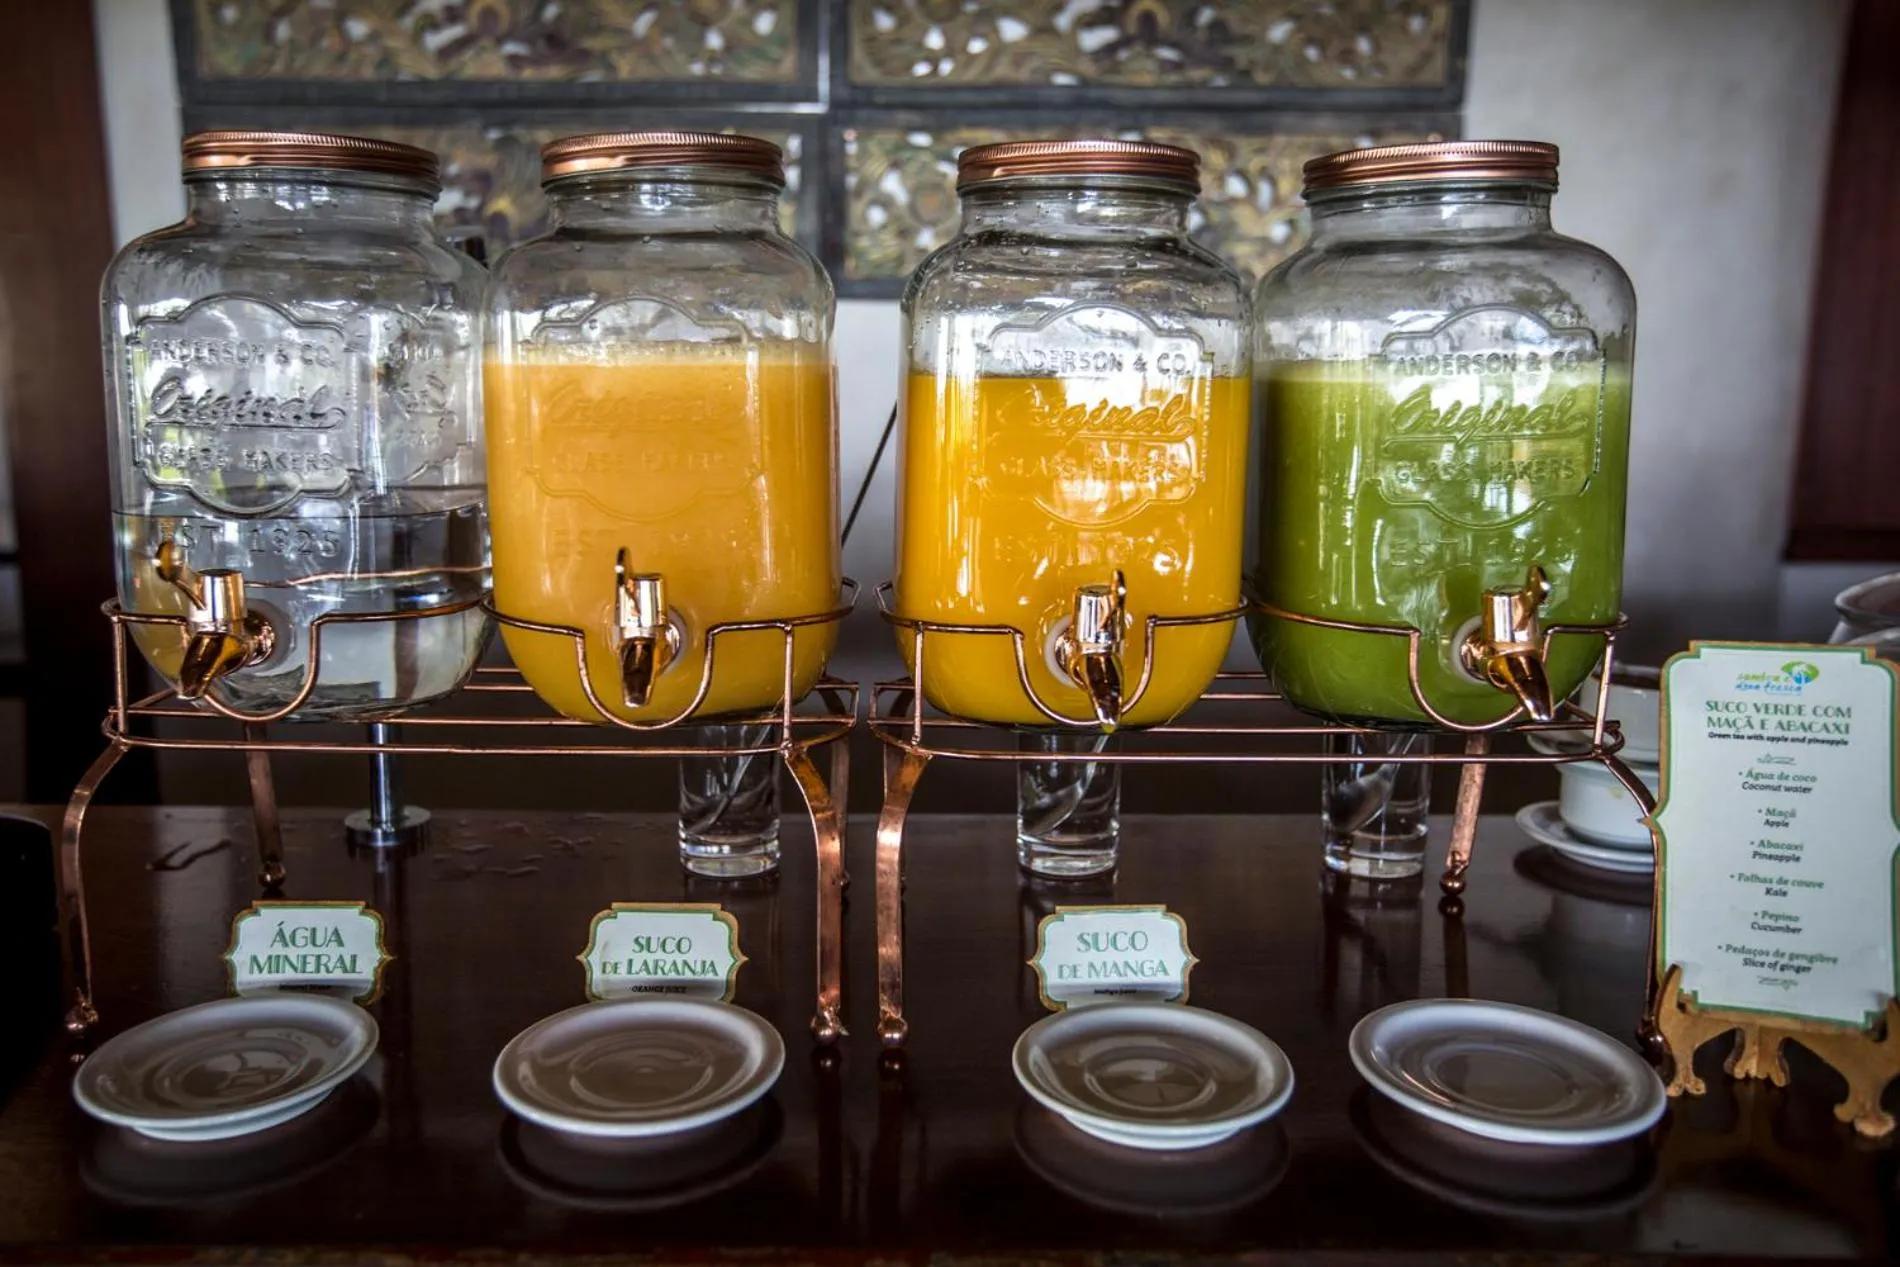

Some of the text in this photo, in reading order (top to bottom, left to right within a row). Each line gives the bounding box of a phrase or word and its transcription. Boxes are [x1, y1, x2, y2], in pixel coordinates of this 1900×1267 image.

[1000, 349, 1124, 376] ANDERSON
[1132, 354, 1148, 374] &
[1394, 352, 1517, 376] ANDERSON
[1525, 351, 1543, 372] &
[148, 374, 347, 429] Original
[1389, 384, 1590, 446] Original
[1705, 700, 1852, 719] SUCO VERDE COM
[1706, 715, 1851, 735] MAÇÃ E ABACAXI
[1708, 731, 1732, 740] Green
[1746, 733, 1765, 741] with
[1766, 735, 1789, 744] apple
[1790, 735, 1806, 744] and
[1807, 737, 1849, 746] pineapple
[1777, 771, 1790, 781] de
[1792, 774, 1818, 783] coco
[1742, 781, 1813, 794] Coconut water
[1763, 819, 1790, 829] Apple
[1752, 850, 1801, 862] Pineapple
[1775, 876, 1789, 886] de
[1764, 887, 1788, 898] Kale
[1761, 910, 1801, 922] Pepino
[270, 920, 345, 949] ÁGUA
[1751, 921, 1803, 934] Cucumber
[632, 936, 692, 955] SUCO
[1076, 931, 1149, 952] SUCO
[249, 953, 363, 974] MINERAL
[601, 958, 719, 976] DE LARANJA
[1057, 959, 1170, 979] DE MANGA
[1742, 957, 1766, 968] Slice
[1767, 960, 1780, 971] of
